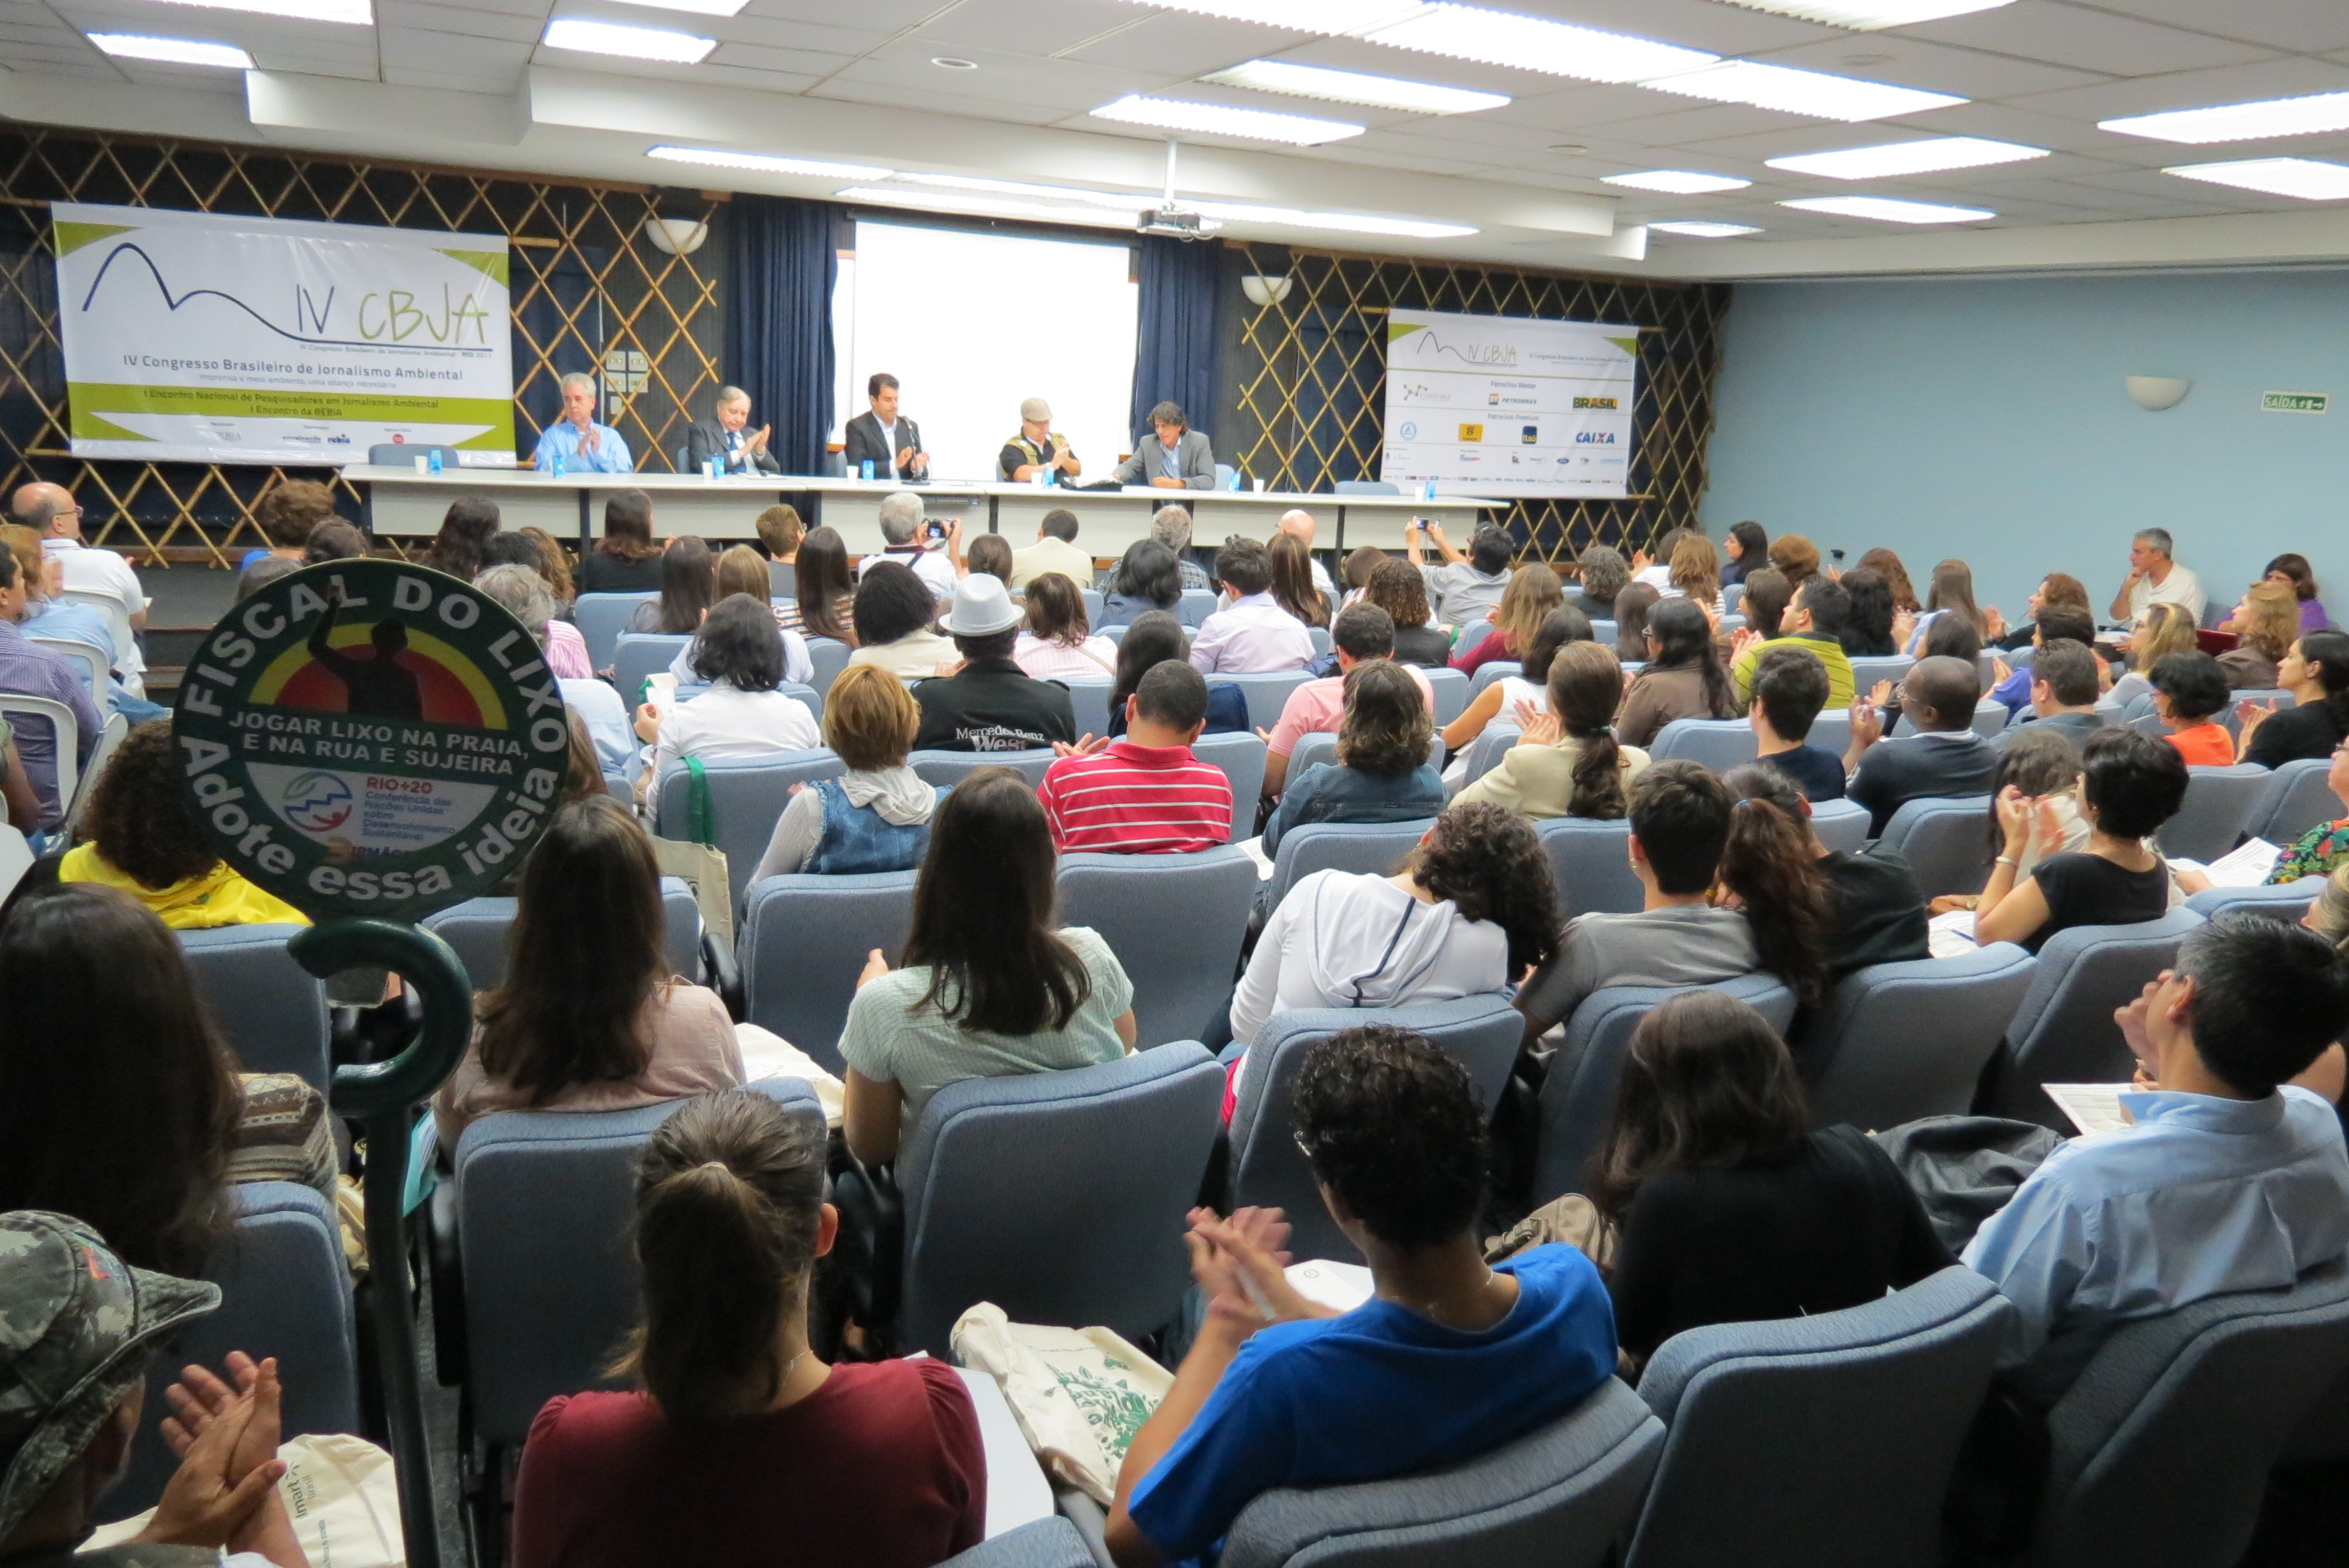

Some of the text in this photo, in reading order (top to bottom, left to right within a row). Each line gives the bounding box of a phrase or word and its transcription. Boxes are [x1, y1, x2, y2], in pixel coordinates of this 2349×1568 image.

[296, 282, 489, 344] IV CBJA
[1483, 342, 1517, 363] CBJA
[123, 354, 464, 380] IV Congresso Brasileiro de Jornalismo Ambiental
[149, 389, 194, 400] Encontro
[196, 391, 239, 401] Nacional
[240, 392, 252, 402] de
[254, 394, 324, 405] Pesquisadores
[343, 396, 391, 407] Jornalismo
[394, 399, 439, 409] Ambiental
[1572, 397, 1618, 410] BRASIL
[256, 405, 299, 415] Encontro
[301, 407, 312, 415] da
[327, 434, 351, 444] rebia
[1576, 432, 1615, 444] CAIXA
[184, 574, 566, 753] FISCAL DO LIXO
[229, 711, 529, 760] JOGAR LIXO NA PRAIA,
[243, 733, 259, 750] E
[269, 735, 306, 755] NA
[315, 740, 370, 762] RUA
[404, 750, 514, 776] SUJEIRA
[366, 776, 433, 794] RIO+20
[179, 734, 559, 901] Adote essa ideia
